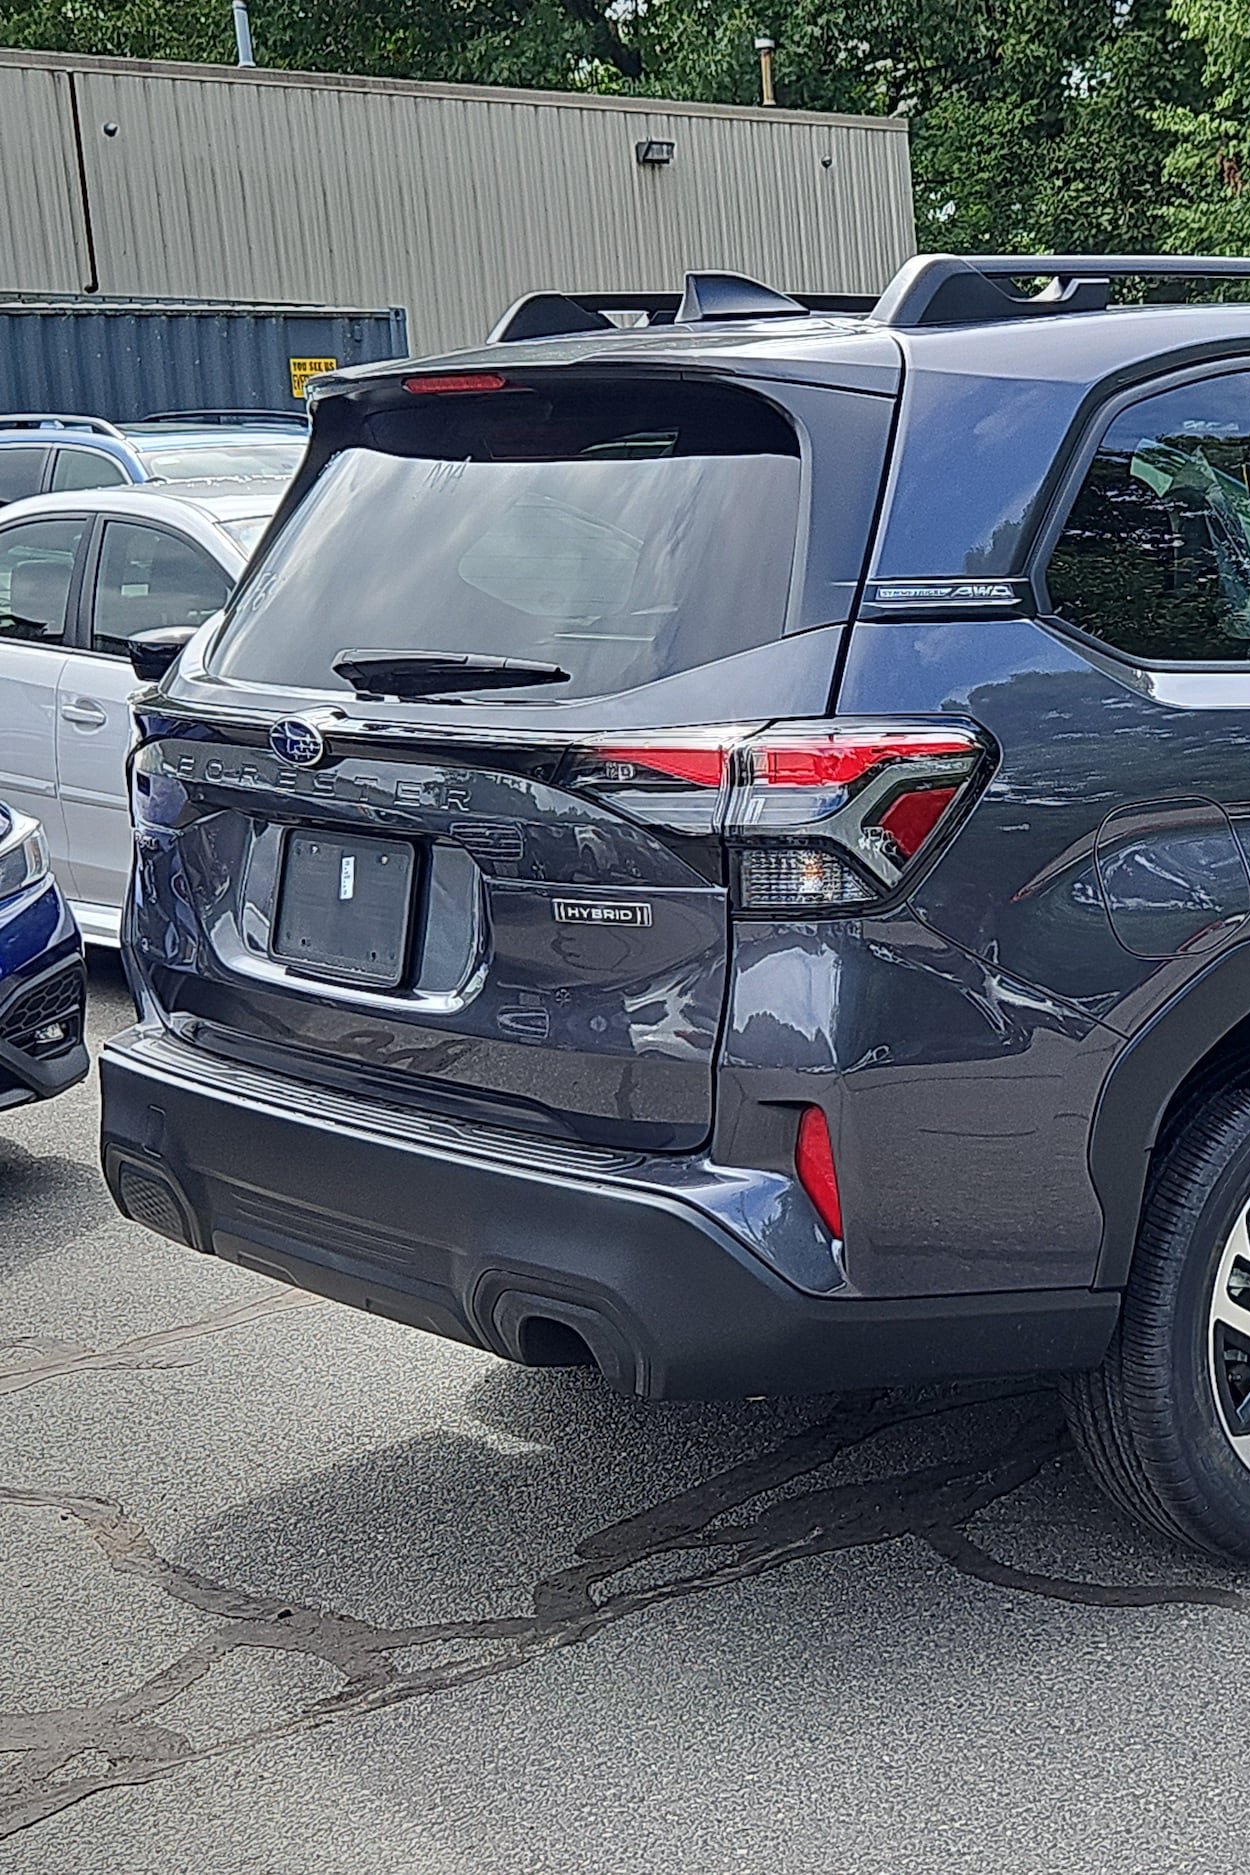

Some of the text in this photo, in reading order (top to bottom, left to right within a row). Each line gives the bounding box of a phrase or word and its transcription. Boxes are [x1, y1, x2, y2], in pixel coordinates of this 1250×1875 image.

[951, 584, 1013, 598] AWD
[176, 754, 472, 812] FORESTER
[567, 907, 633, 921] HYBRID
